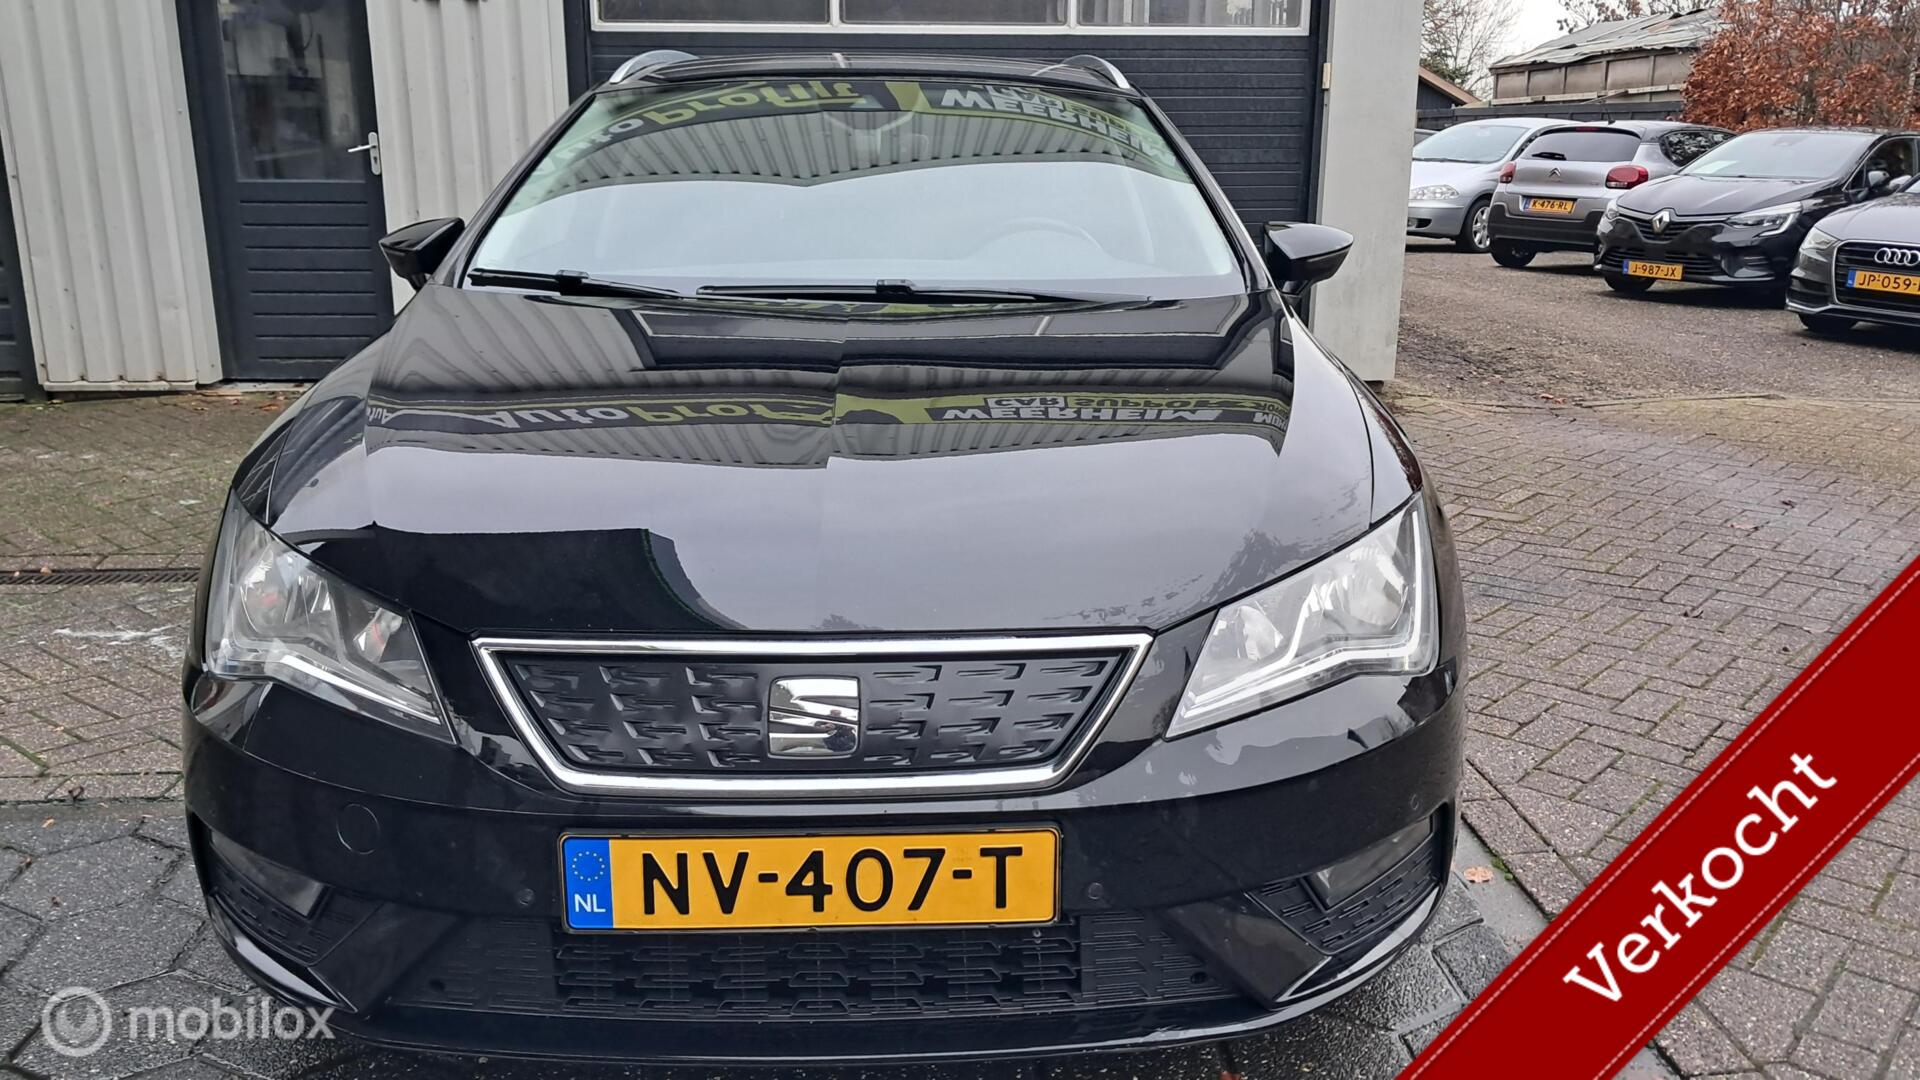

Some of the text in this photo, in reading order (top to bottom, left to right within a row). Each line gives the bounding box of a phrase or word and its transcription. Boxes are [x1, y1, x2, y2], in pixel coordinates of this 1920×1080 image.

[1532, 200, 1568, 210] K-476-RL
[1632, 264, 1677, 277] J-987-JX
[1859, 274, 1920, 291] JP-059-
[574, 846, 1023, 915] NL NV-407-T
